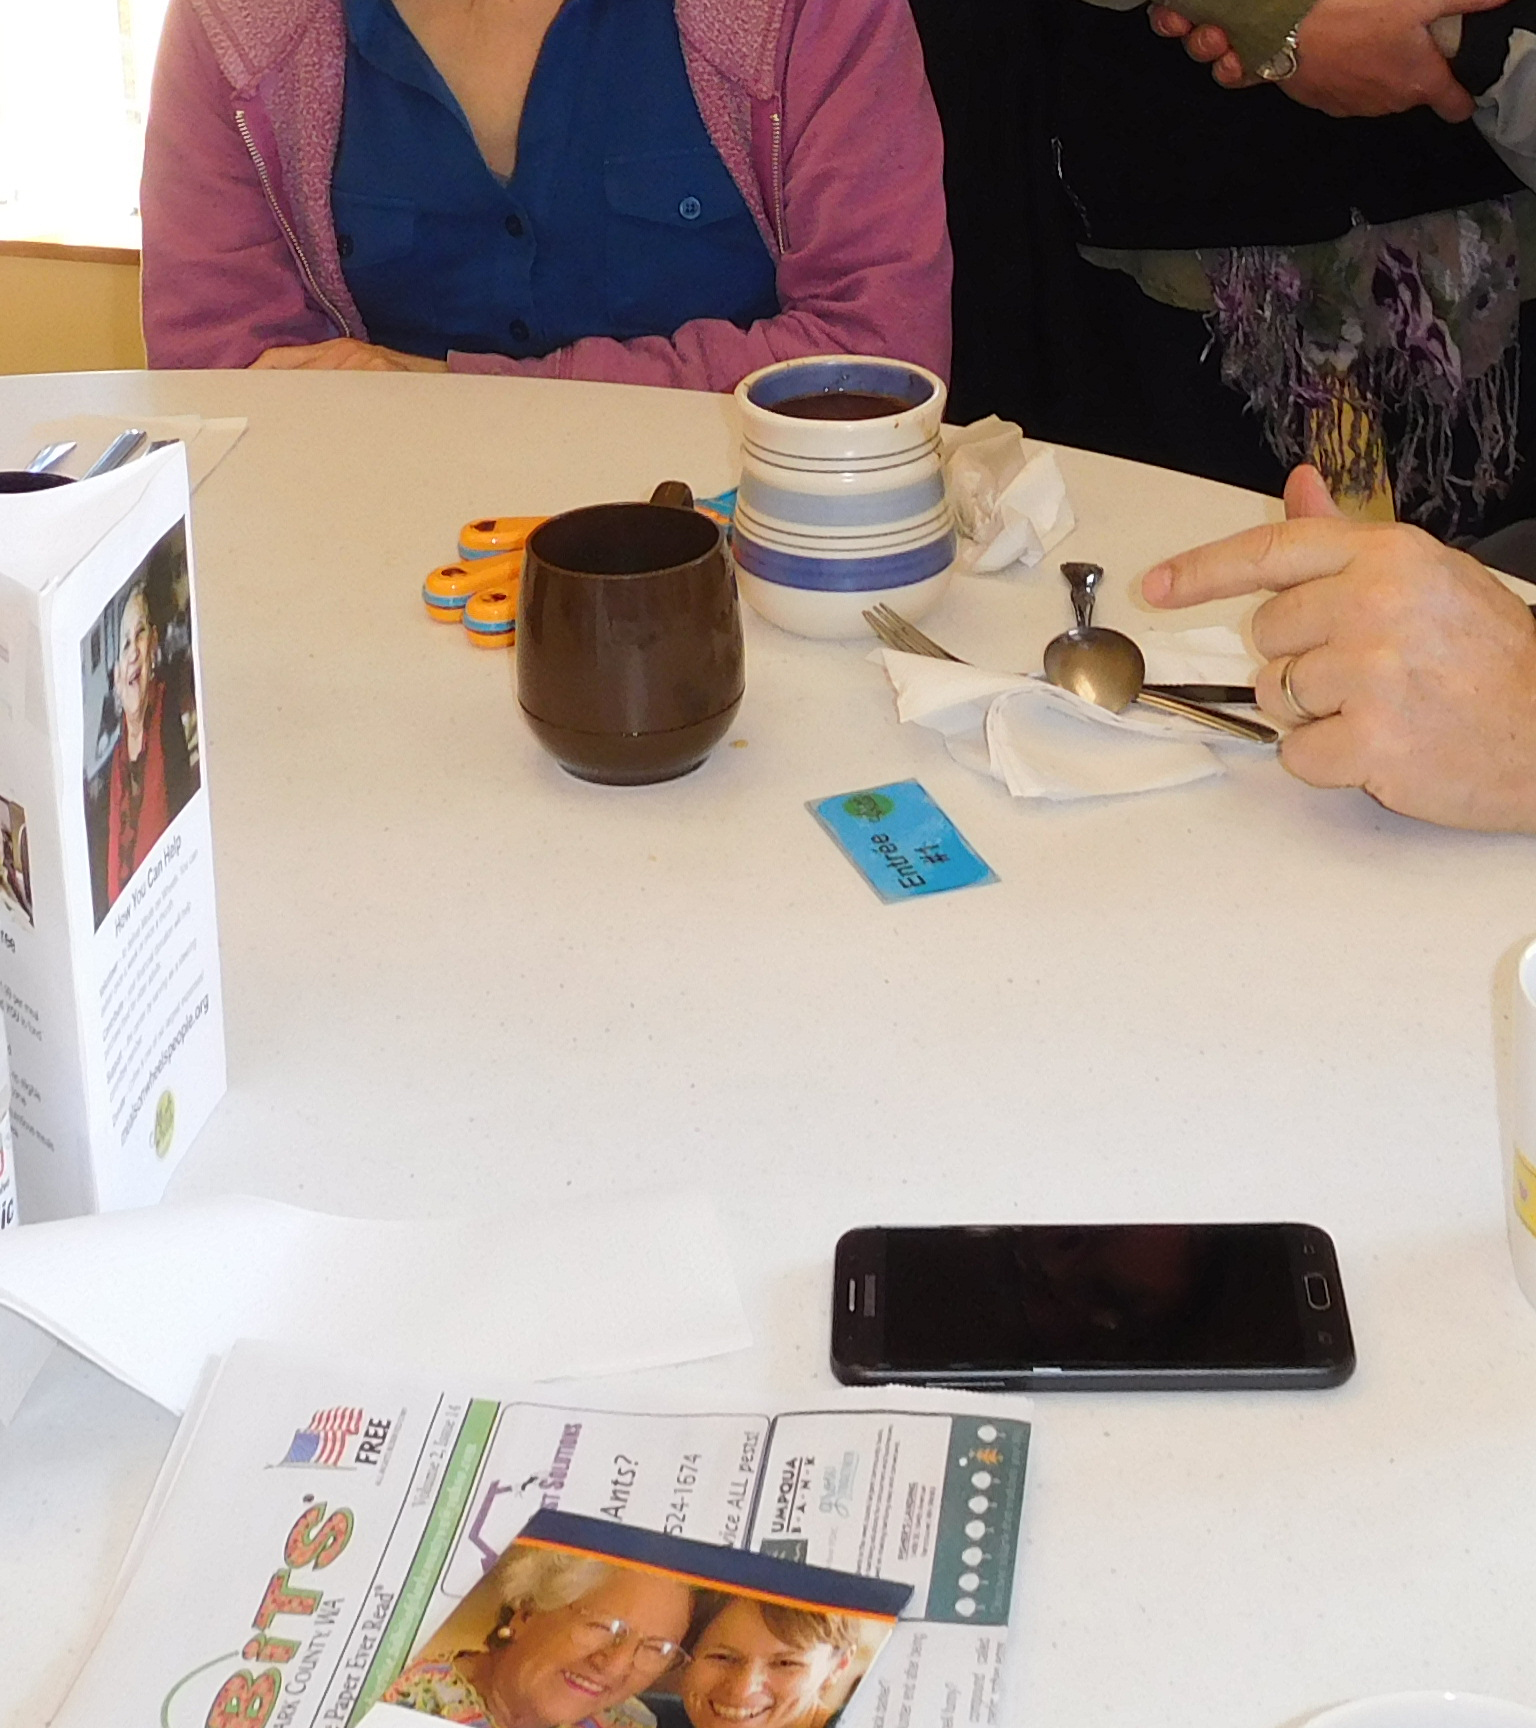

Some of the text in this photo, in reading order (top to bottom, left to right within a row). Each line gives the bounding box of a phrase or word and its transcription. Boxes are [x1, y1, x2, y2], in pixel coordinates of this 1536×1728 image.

[148, 859, 163, 888] Can
[914, 843, 950, 866] #1
[354, 1418, 392, 1466] FREE
[600, 1454, 639, 1521] Ants?
[664, 1453, 701, 1536] 524-1674
[727, 1477, 749, 1511] ALL
[771, 1456, 799, 1533] UMPQUA
[324, 1674, 360, 1721] Paper
[346, 1635, 376, 1669] Ever
